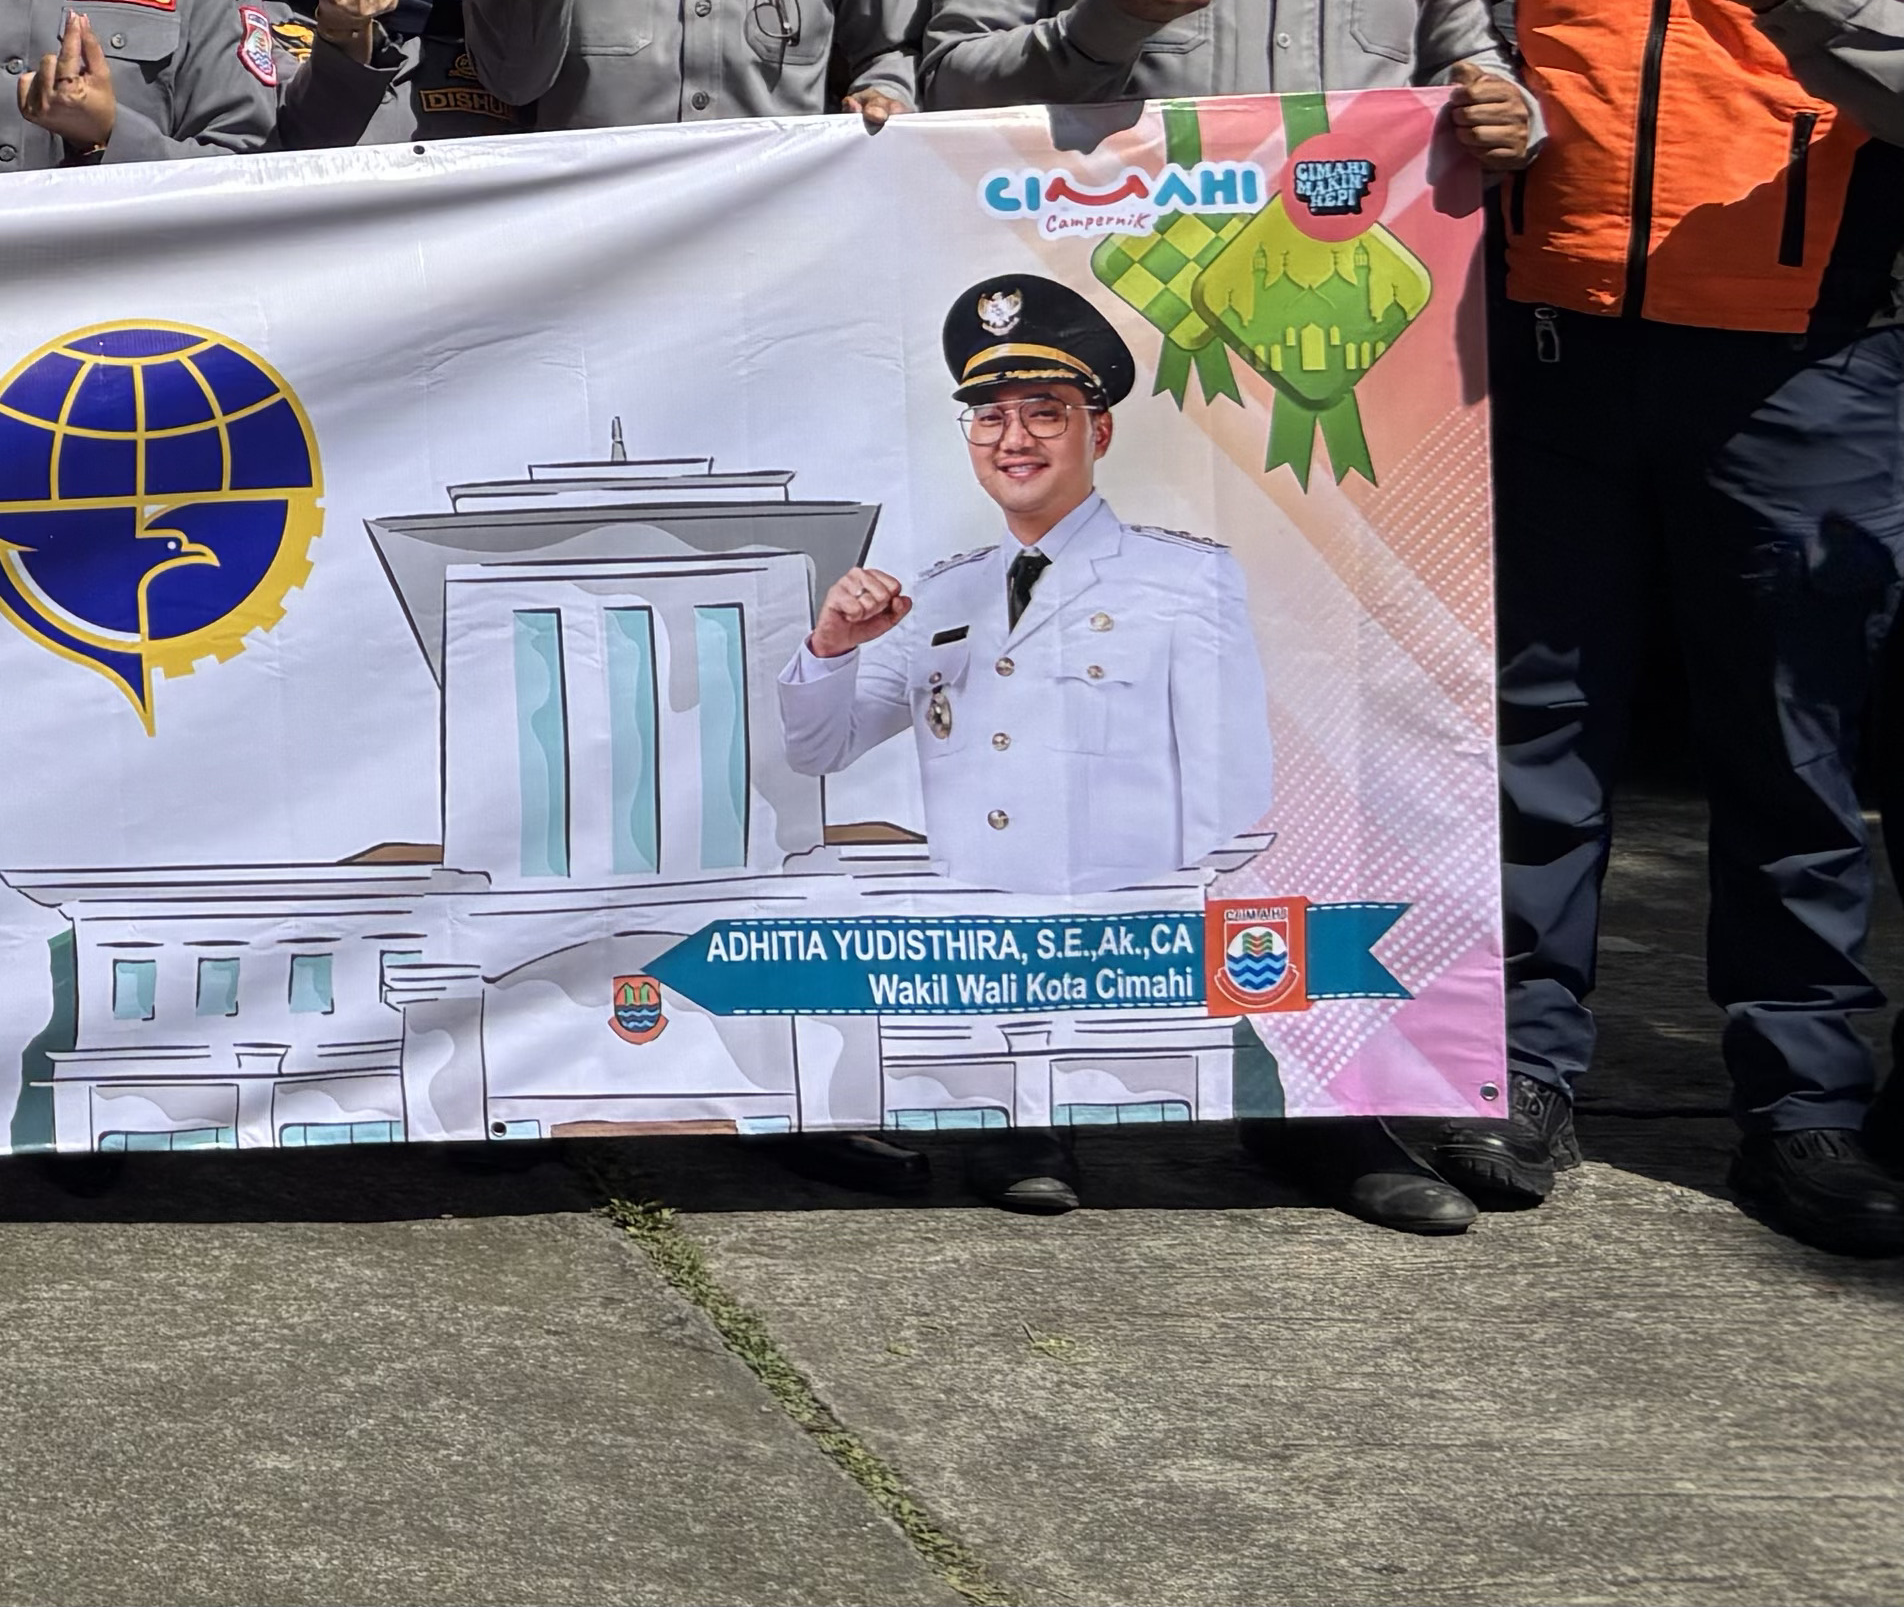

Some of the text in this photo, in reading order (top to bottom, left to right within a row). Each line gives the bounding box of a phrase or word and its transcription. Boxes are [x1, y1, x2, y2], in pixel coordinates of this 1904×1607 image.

[428, 90, 511, 116] DISHU
[1294, 160, 1370, 181] CIMAHI
[983, 167, 1259, 213] CIMAHI
[1309, 191, 1356, 208] HEPI
[706, 929, 825, 965] ADHITIA
[836, 925, 1029, 967] YUDISTHIRA,
[868, 965, 1195, 1007] Wakil Wali Kota Cimahi
